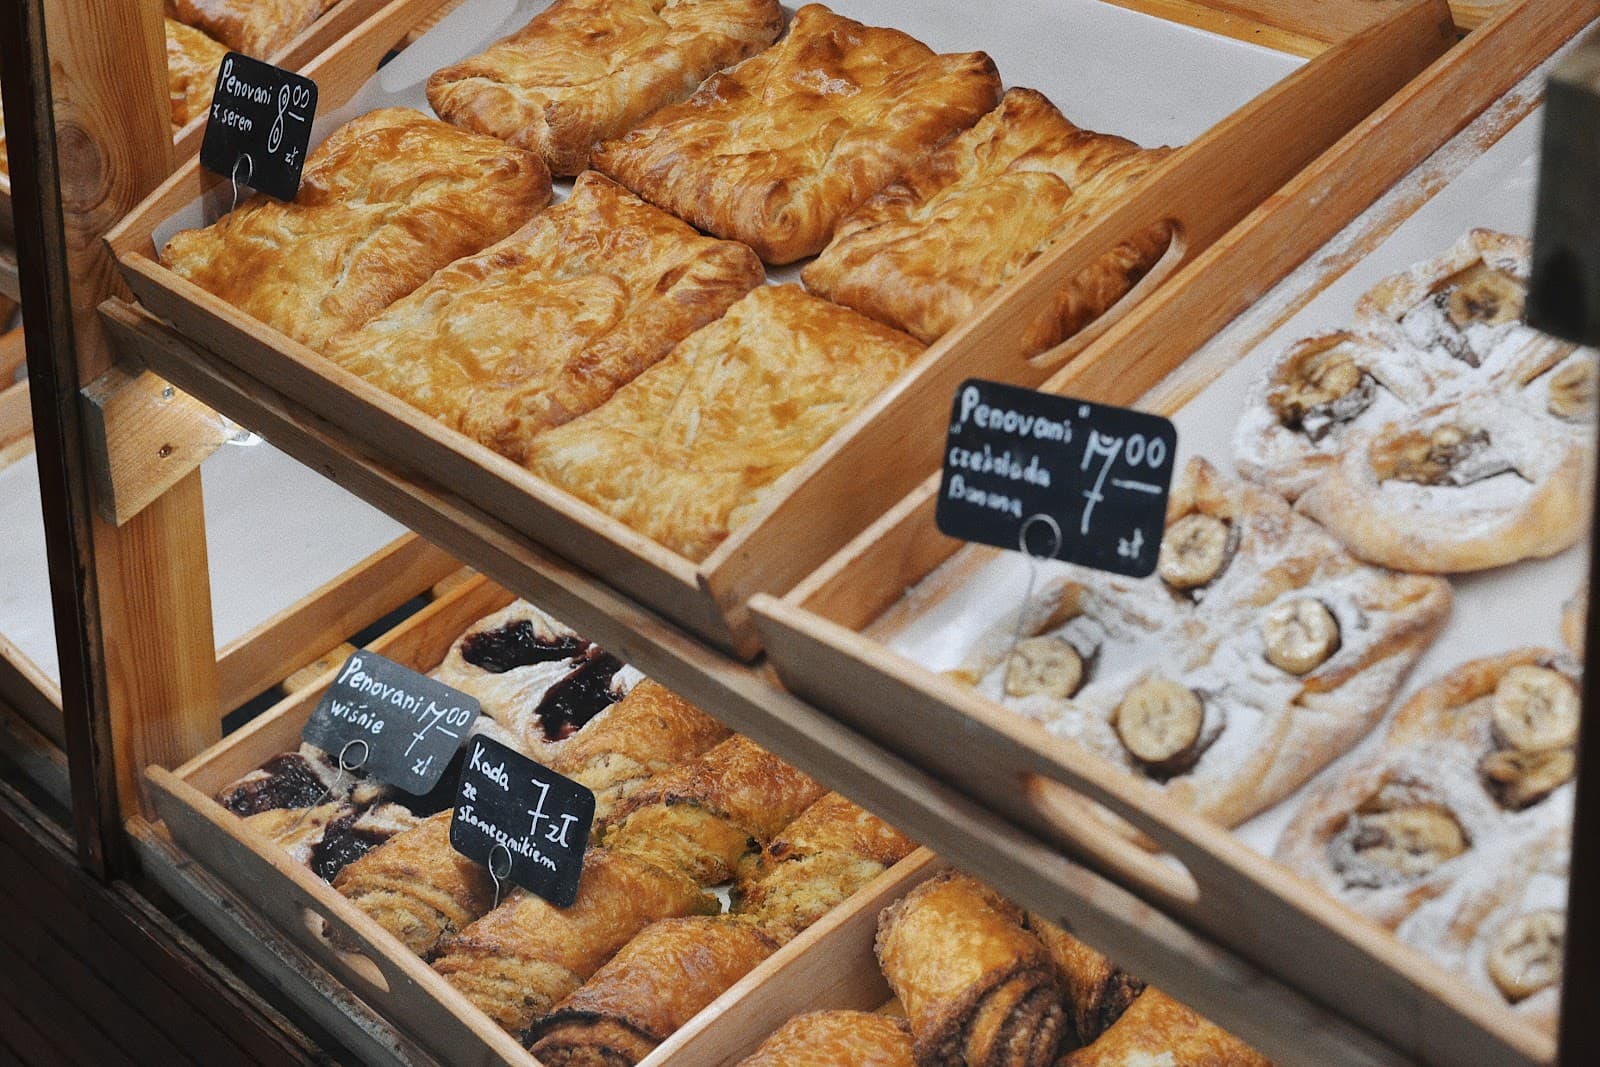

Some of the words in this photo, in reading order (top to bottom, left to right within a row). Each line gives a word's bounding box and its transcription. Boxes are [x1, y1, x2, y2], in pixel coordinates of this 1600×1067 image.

[219, 58, 272, 104] Penovani
[222, 108, 253, 132] serem
[338, 655, 424, 714] Penovani
[330, 699, 385, 734] wiśnie
[462, 782, 478, 802] ze
